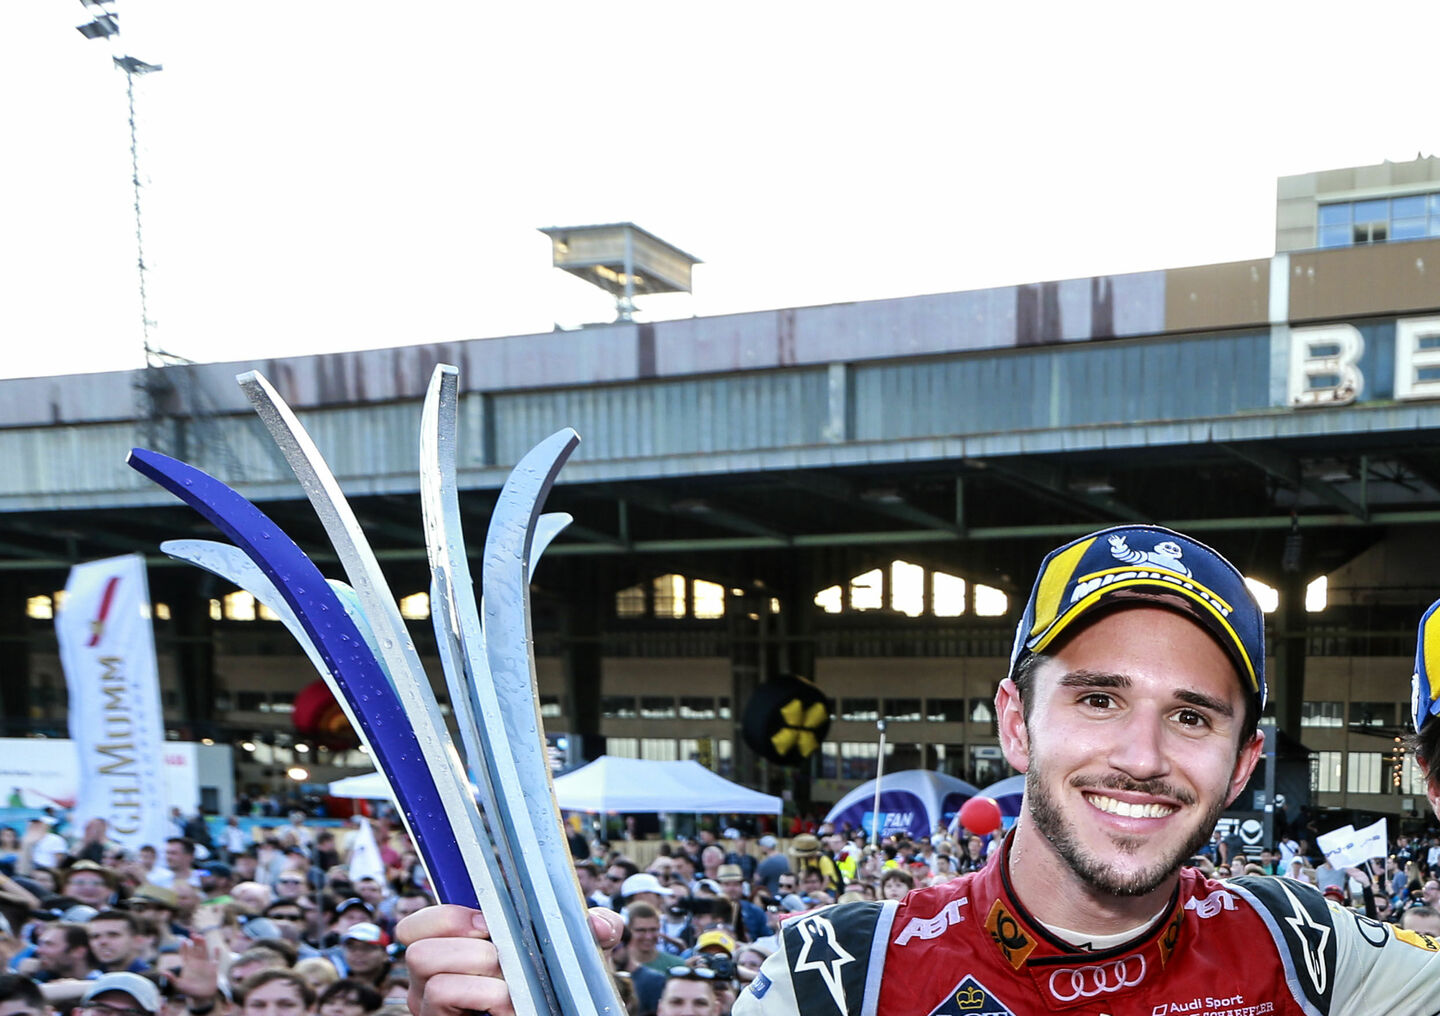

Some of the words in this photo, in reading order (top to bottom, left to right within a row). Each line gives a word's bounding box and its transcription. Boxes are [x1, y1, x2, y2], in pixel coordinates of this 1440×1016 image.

[884, 811, 914, 829] FAN
[894, 896, 969, 946] ABT
[1170, 998, 1203, 1013] Audi
[1205, 994, 1244, 1010] Sport
